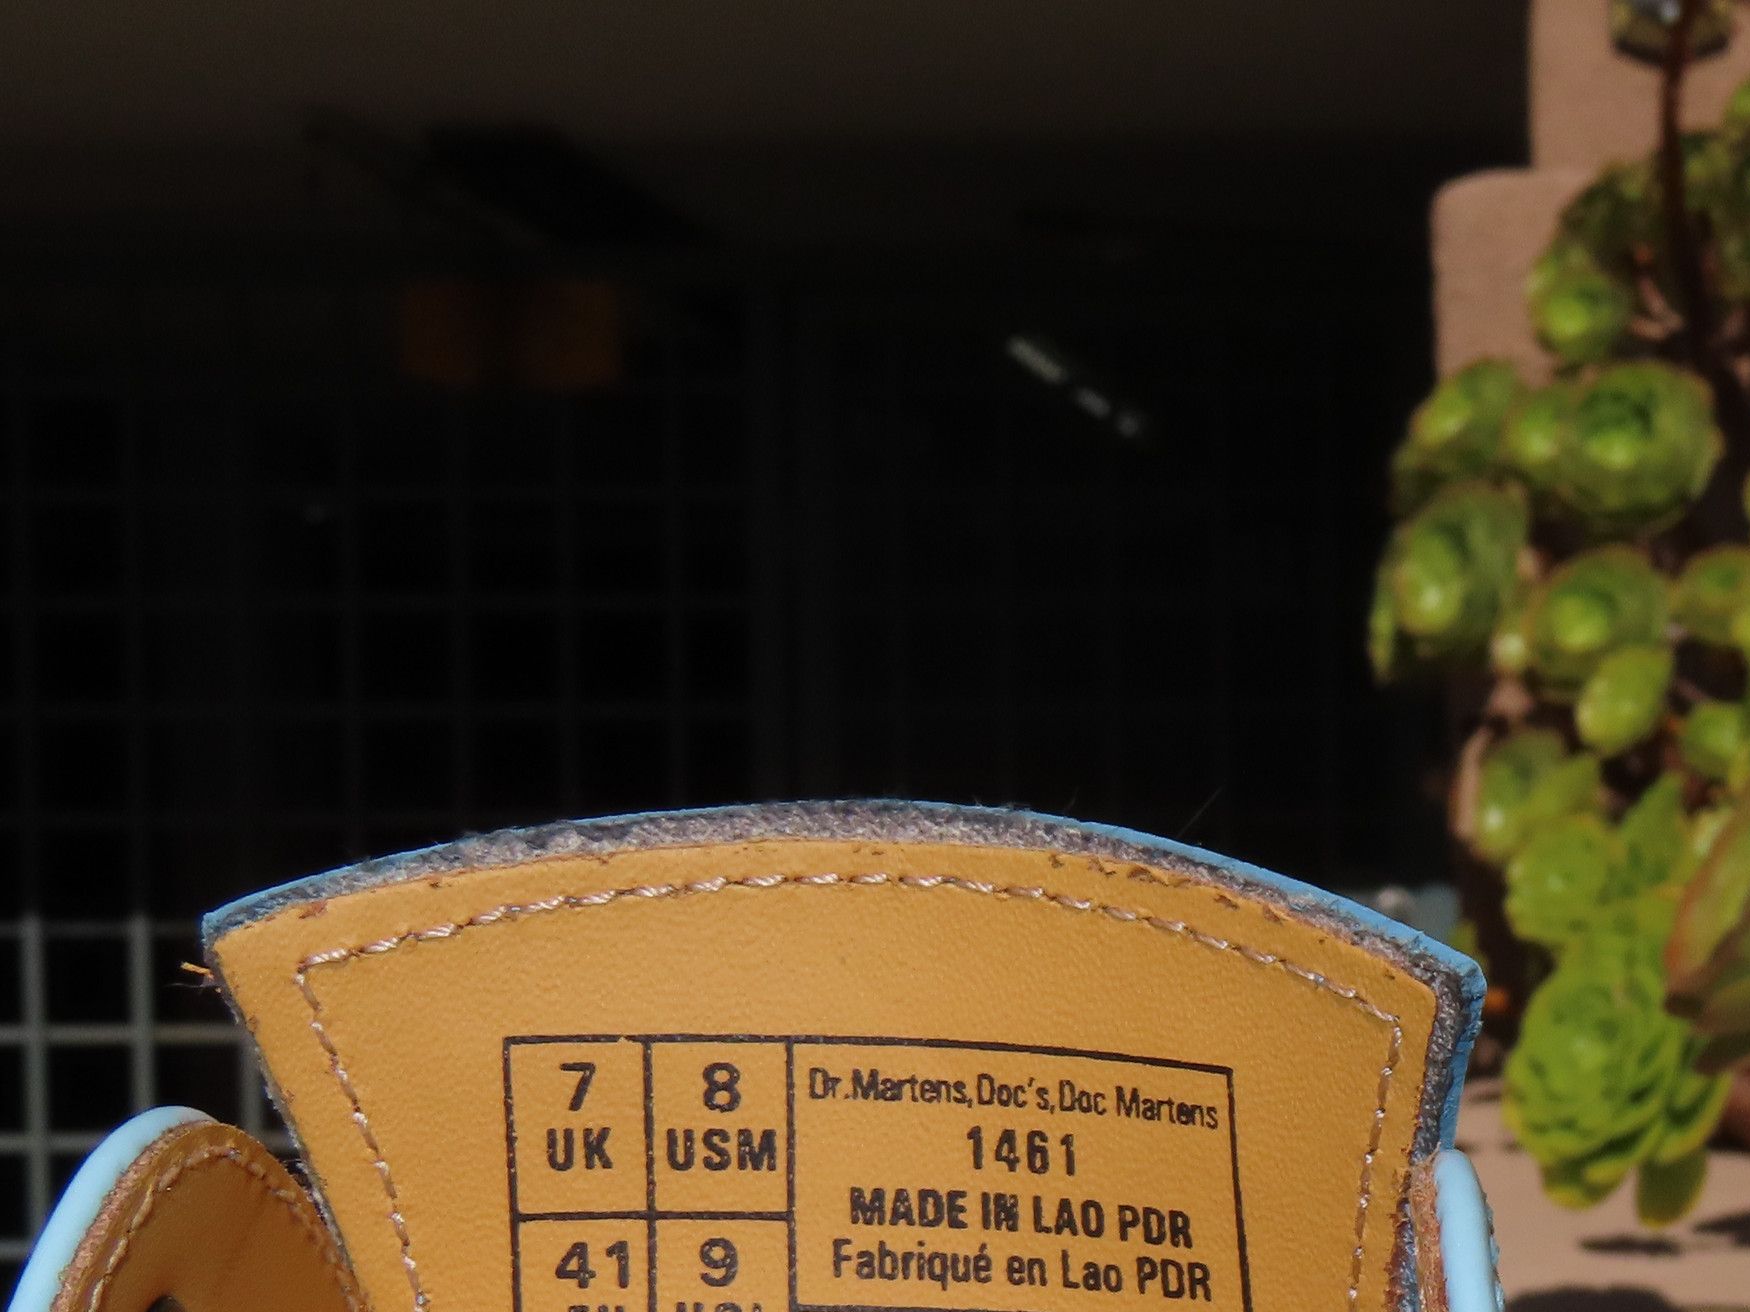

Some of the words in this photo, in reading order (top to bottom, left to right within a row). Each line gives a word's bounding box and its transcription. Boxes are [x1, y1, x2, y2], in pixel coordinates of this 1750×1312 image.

[560, 1062, 596, 1111] 7
[702, 1063, 741, 1113] 8
[1116, 1086, 1218, 1129] Martens
[547, 1127, 613, 1171] UK
[666, 1128, 777, 1171] USM
[967, 1126, 1076, 1176] 1461
[850, 1187, 968, 1229] MADE
[982, 1191, 1018, 1232] IN
[1033, 1196, 1105, 1238] LAO
[1118, 1204, 1193, 1248] PDR
[555, 1241, 629, 1289] 41
[700, 1238, 738, 1287] 9
[833, 1238, 992, 1291] Fabriqué
[1007, 1254, 1047, 1287] en
[1062, 1249, 1122, 1292] Lao
[1137, 1256, 1212, 1302] PDR
